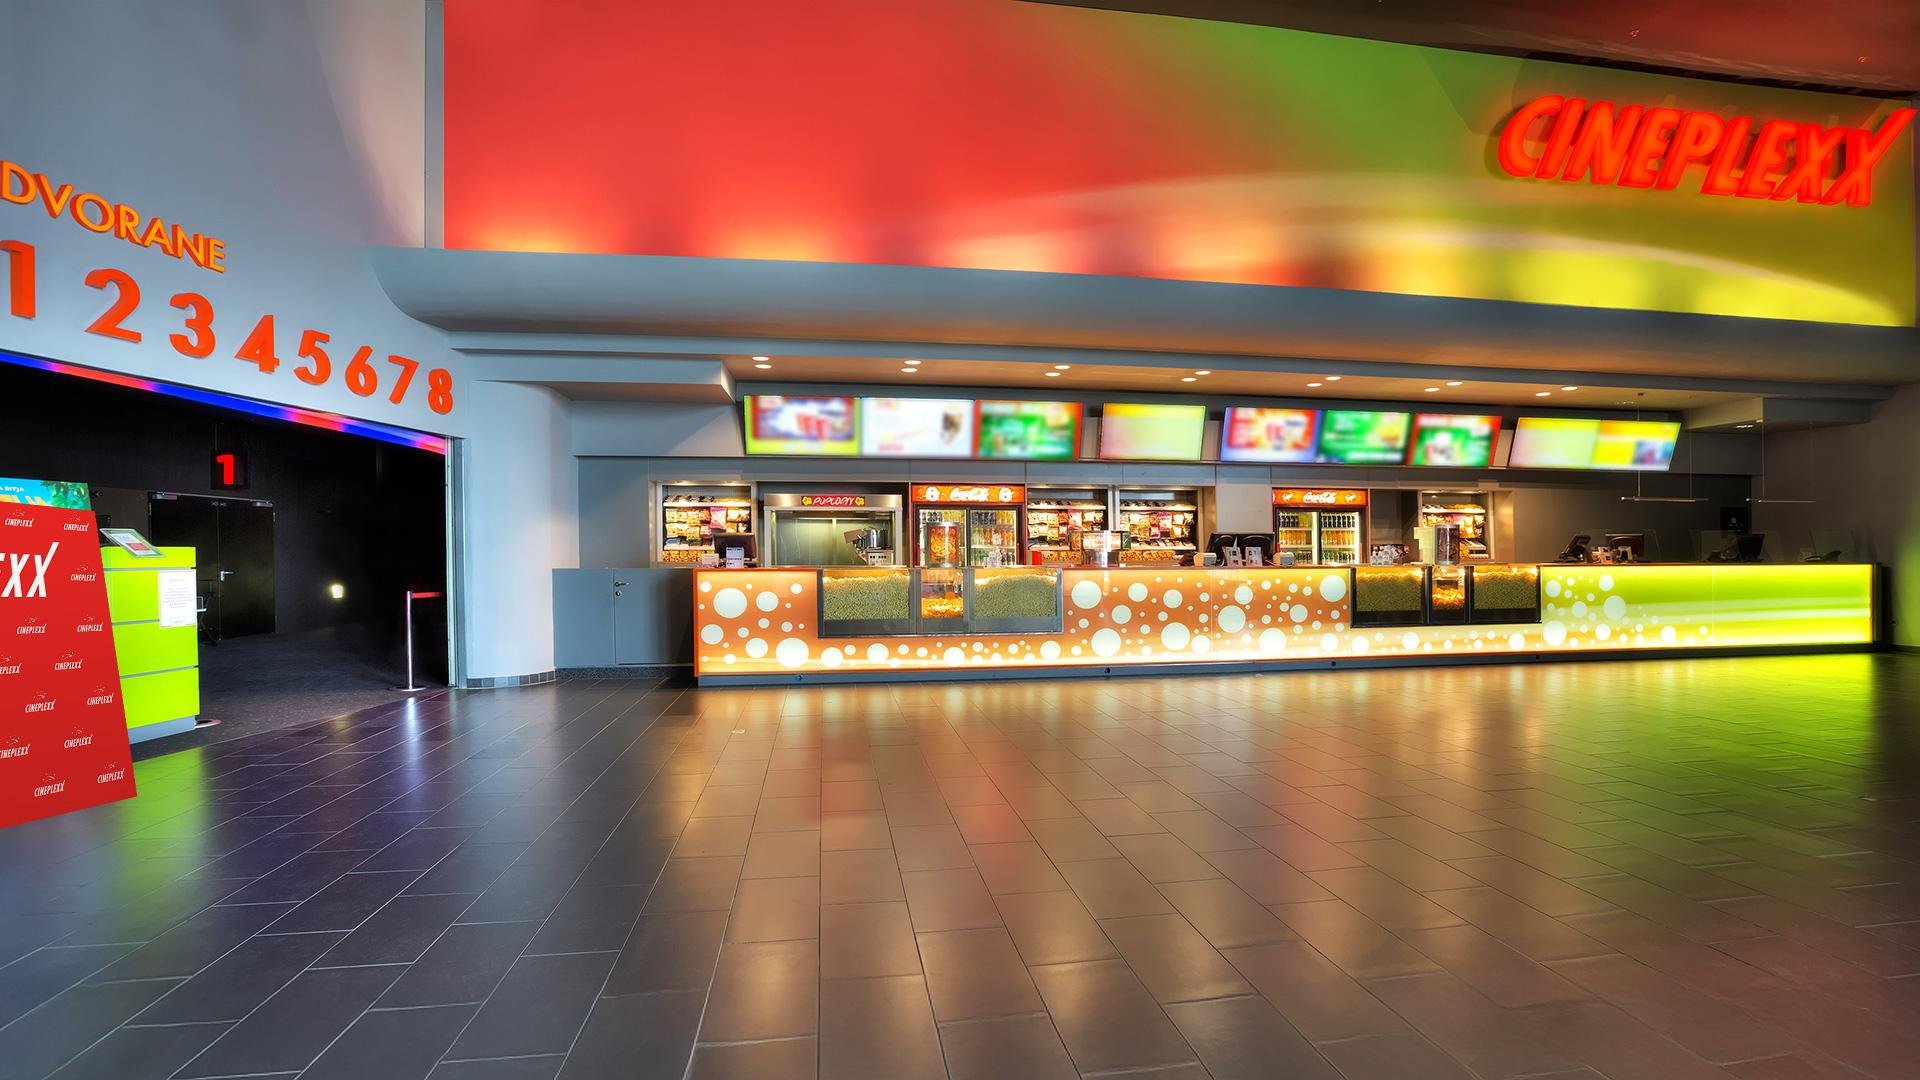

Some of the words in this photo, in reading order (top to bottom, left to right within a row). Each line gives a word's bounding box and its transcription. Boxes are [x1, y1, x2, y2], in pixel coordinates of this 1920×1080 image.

[1497, 94, 1917, 208] CINEPLEXX
[0, 160, 227, 273] DVORANE
[0, 239, 36, 319] 1
[85, 268, 142, 343] 2
[169, 292, 217, 358] 3
[234, 314, 280, 374] 4
[293, 329, 332, 385] 5
[345, 345, 378, 397] 6
[387, 355, 419, 404] 7
[427, 368, 454, 415] 8
[216, 454, 234, 485] 1
[0, 743, 31, 759] INEPLEXX
